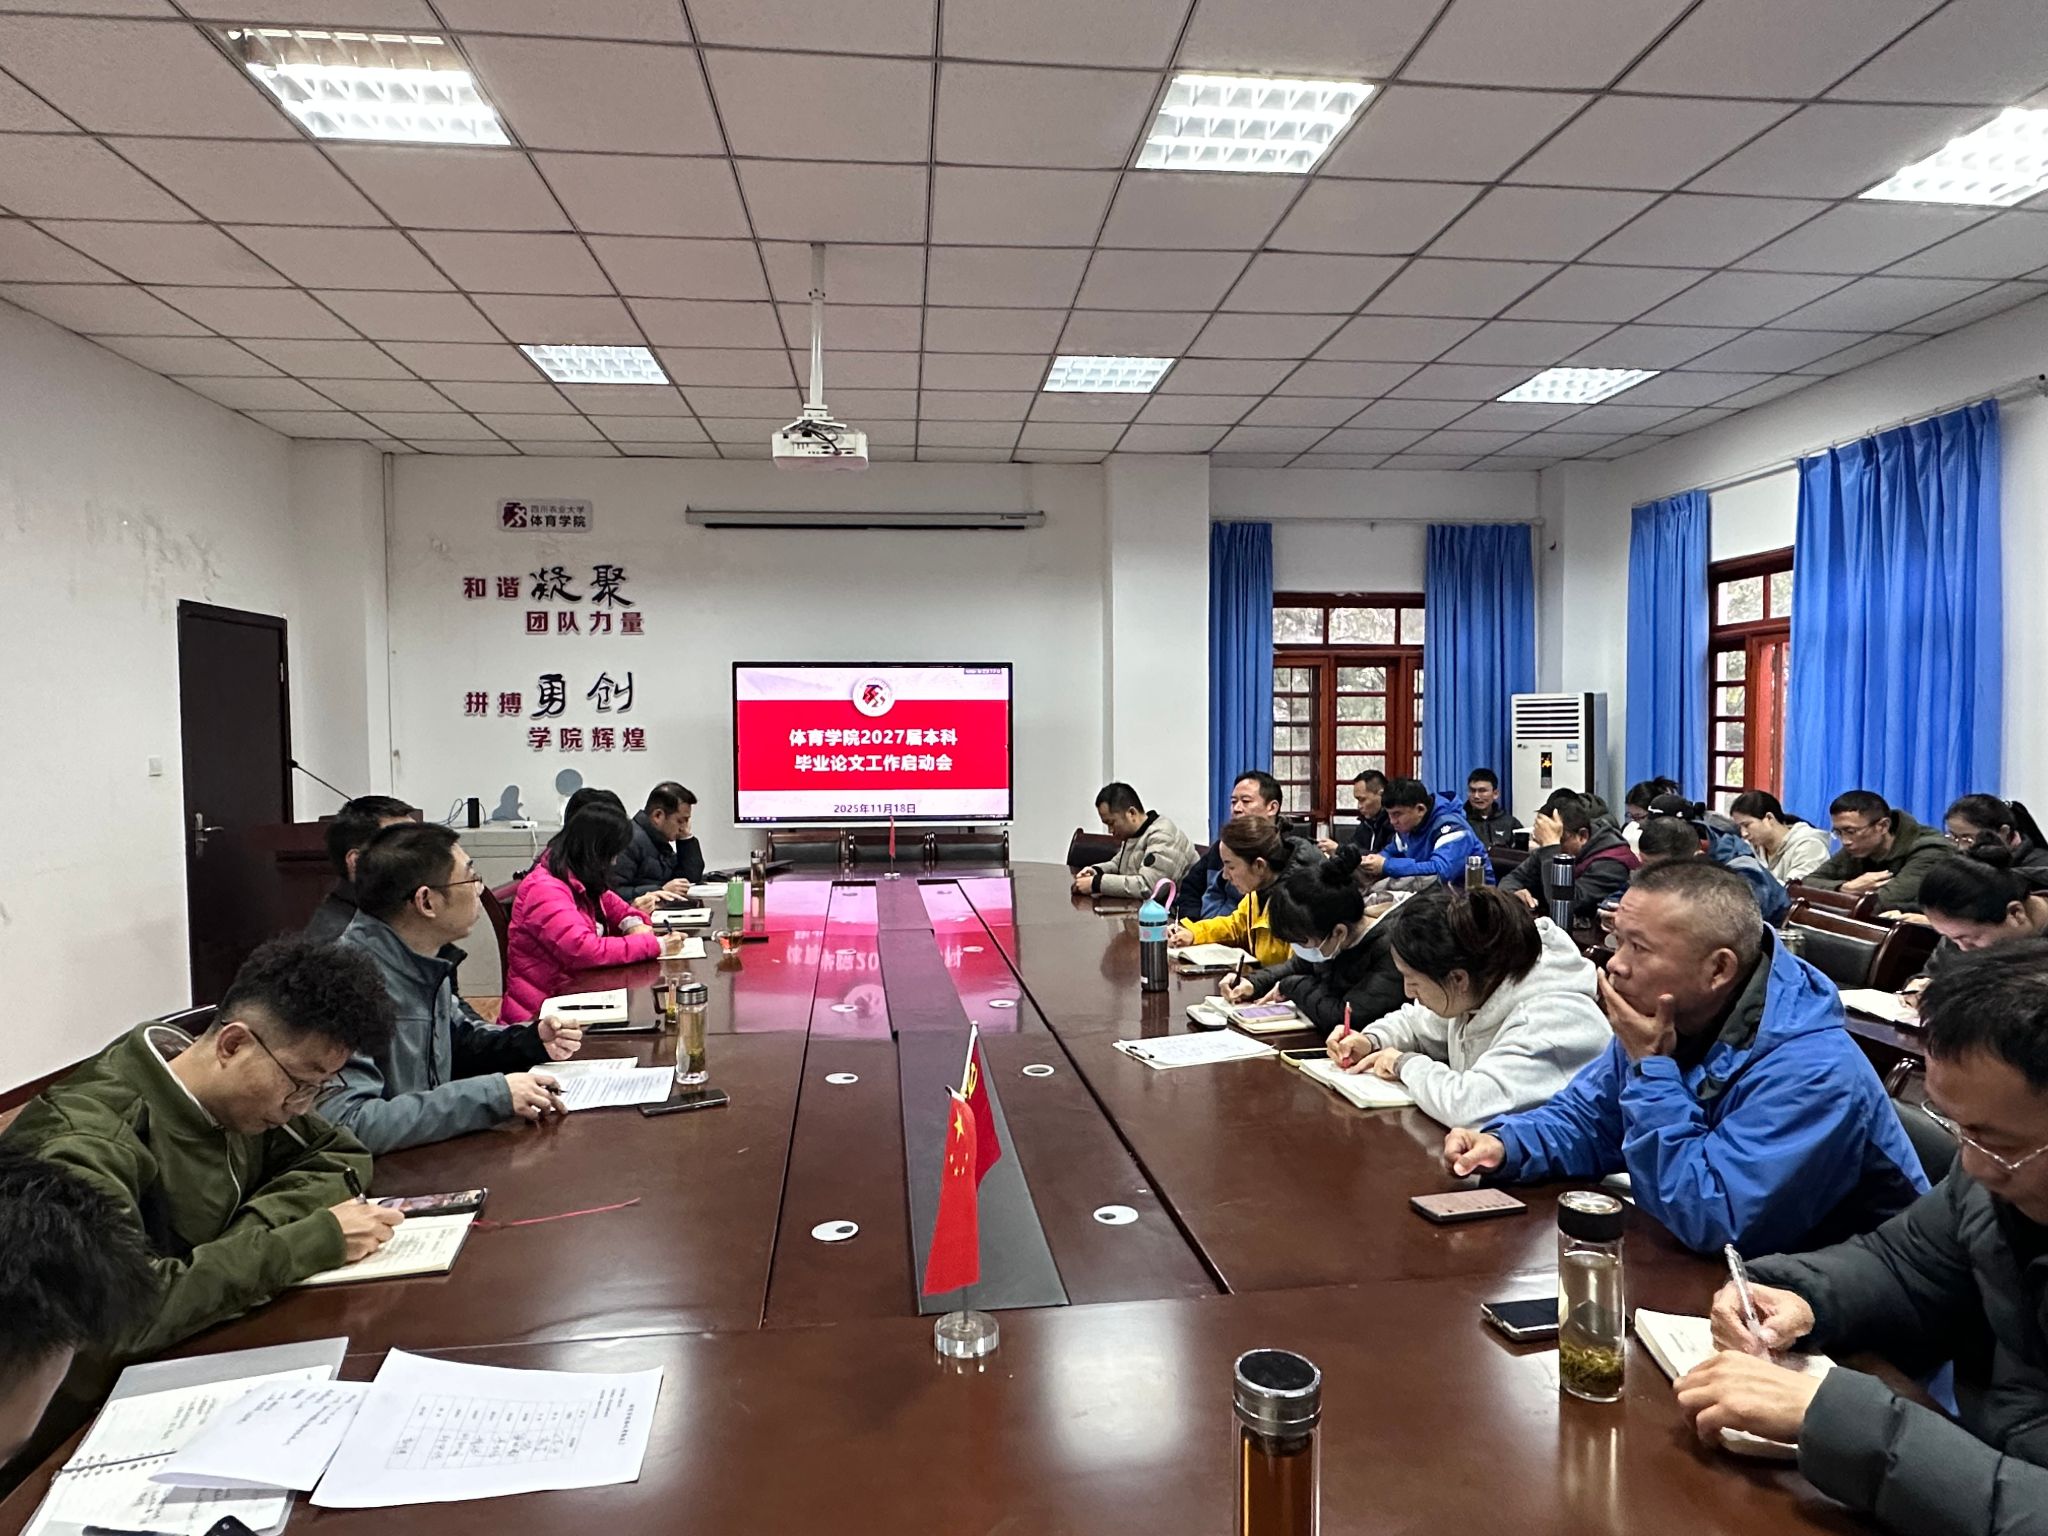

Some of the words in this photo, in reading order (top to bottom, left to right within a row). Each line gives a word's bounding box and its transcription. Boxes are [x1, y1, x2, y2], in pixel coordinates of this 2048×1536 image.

[530, 515, 587, 528] 体育学院
[526, 610, 645, 634] 团队力量
[528, 726, 647, 750] 学院辉煌
[788, 728, 958, 747] 体育学院2027届本科
[794, 753, 953, 773] 毕业论文工作启动会
[833, 803, 917, 815] 2025年11月18日
